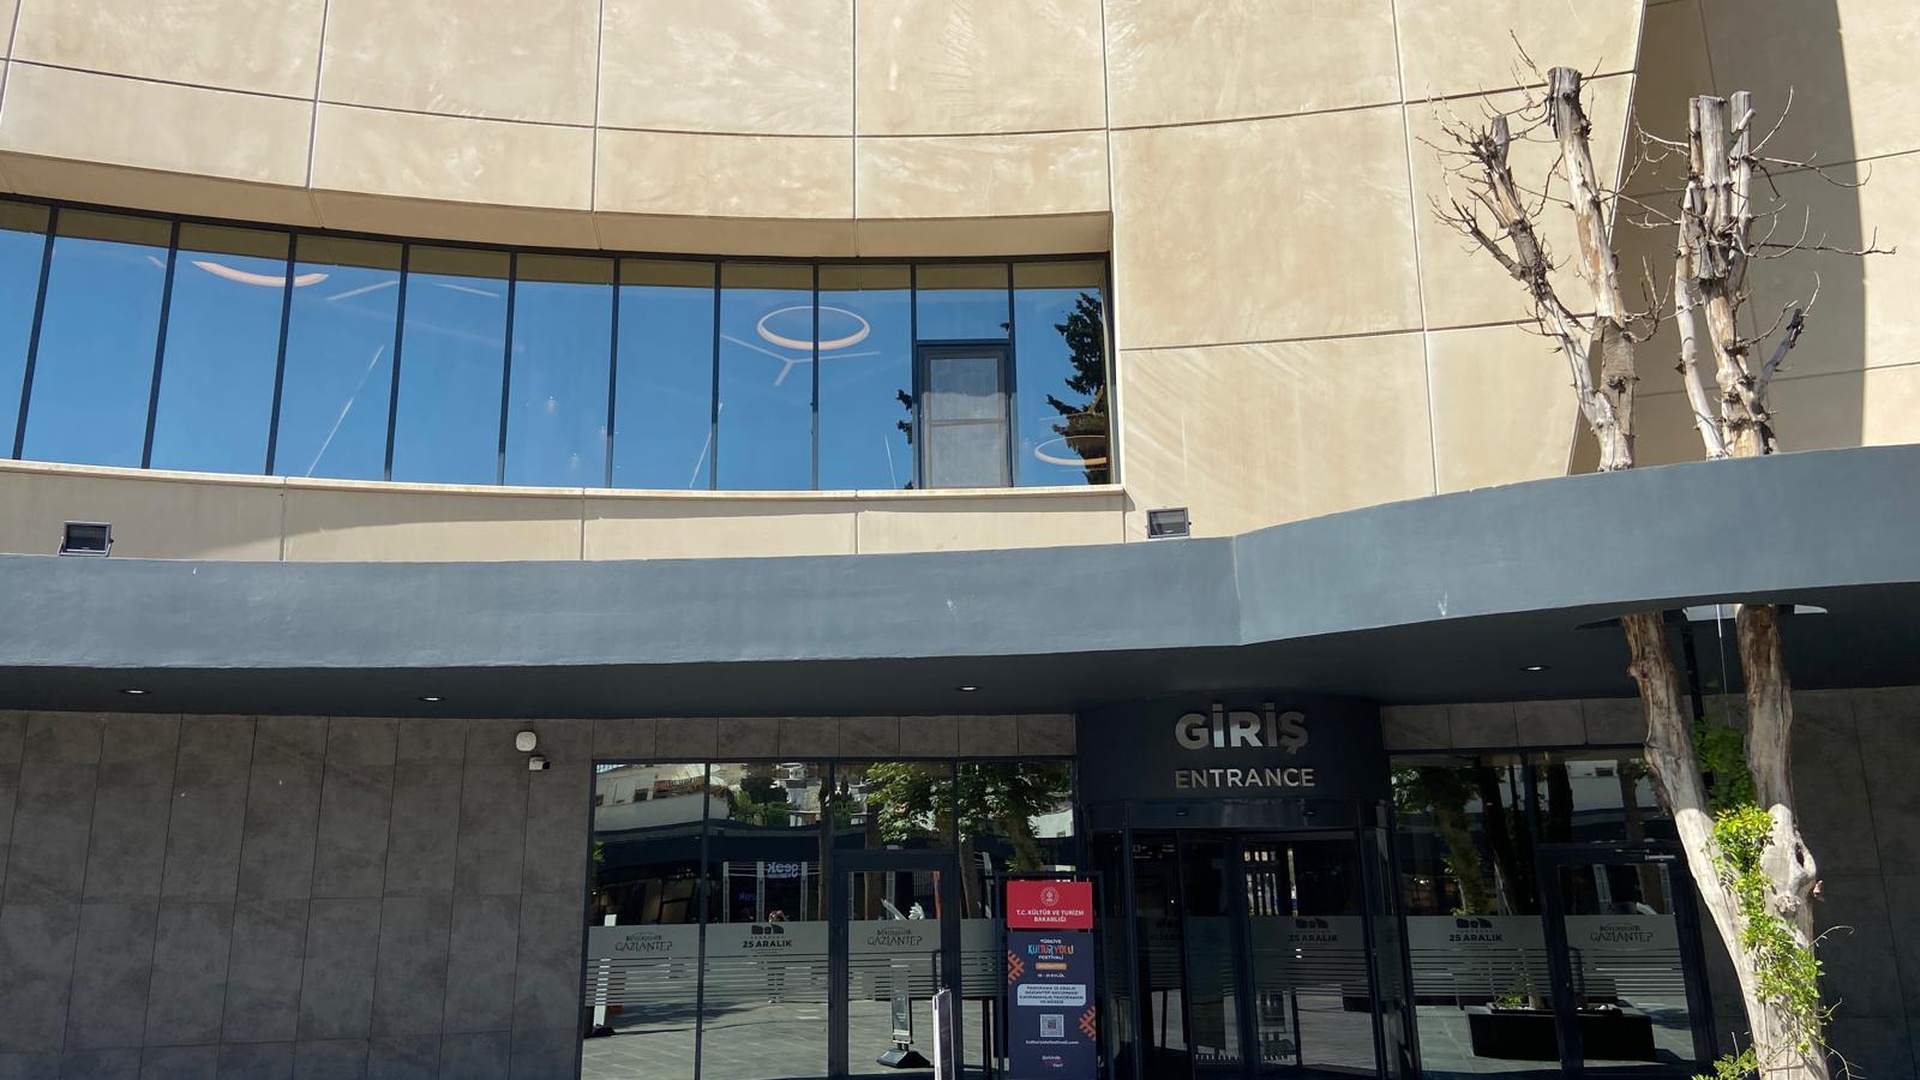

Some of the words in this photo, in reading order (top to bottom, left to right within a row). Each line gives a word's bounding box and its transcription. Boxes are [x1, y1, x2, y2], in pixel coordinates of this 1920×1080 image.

[1175, 702, 1308, 754] GİRİŞ
[1175, 768, 1315, 789] ENTRANCE
[1028, 908, 1051, 916] KÜLTÜR
[1061, 908, 1085, 916] TURİZM
[1302, 934, 1338, 942] ARALIK
[1463, 934, 1503, 942] ARALIK
[742, 940, 754, 948] 25
[755, 939, 793, 948] ARALIK
